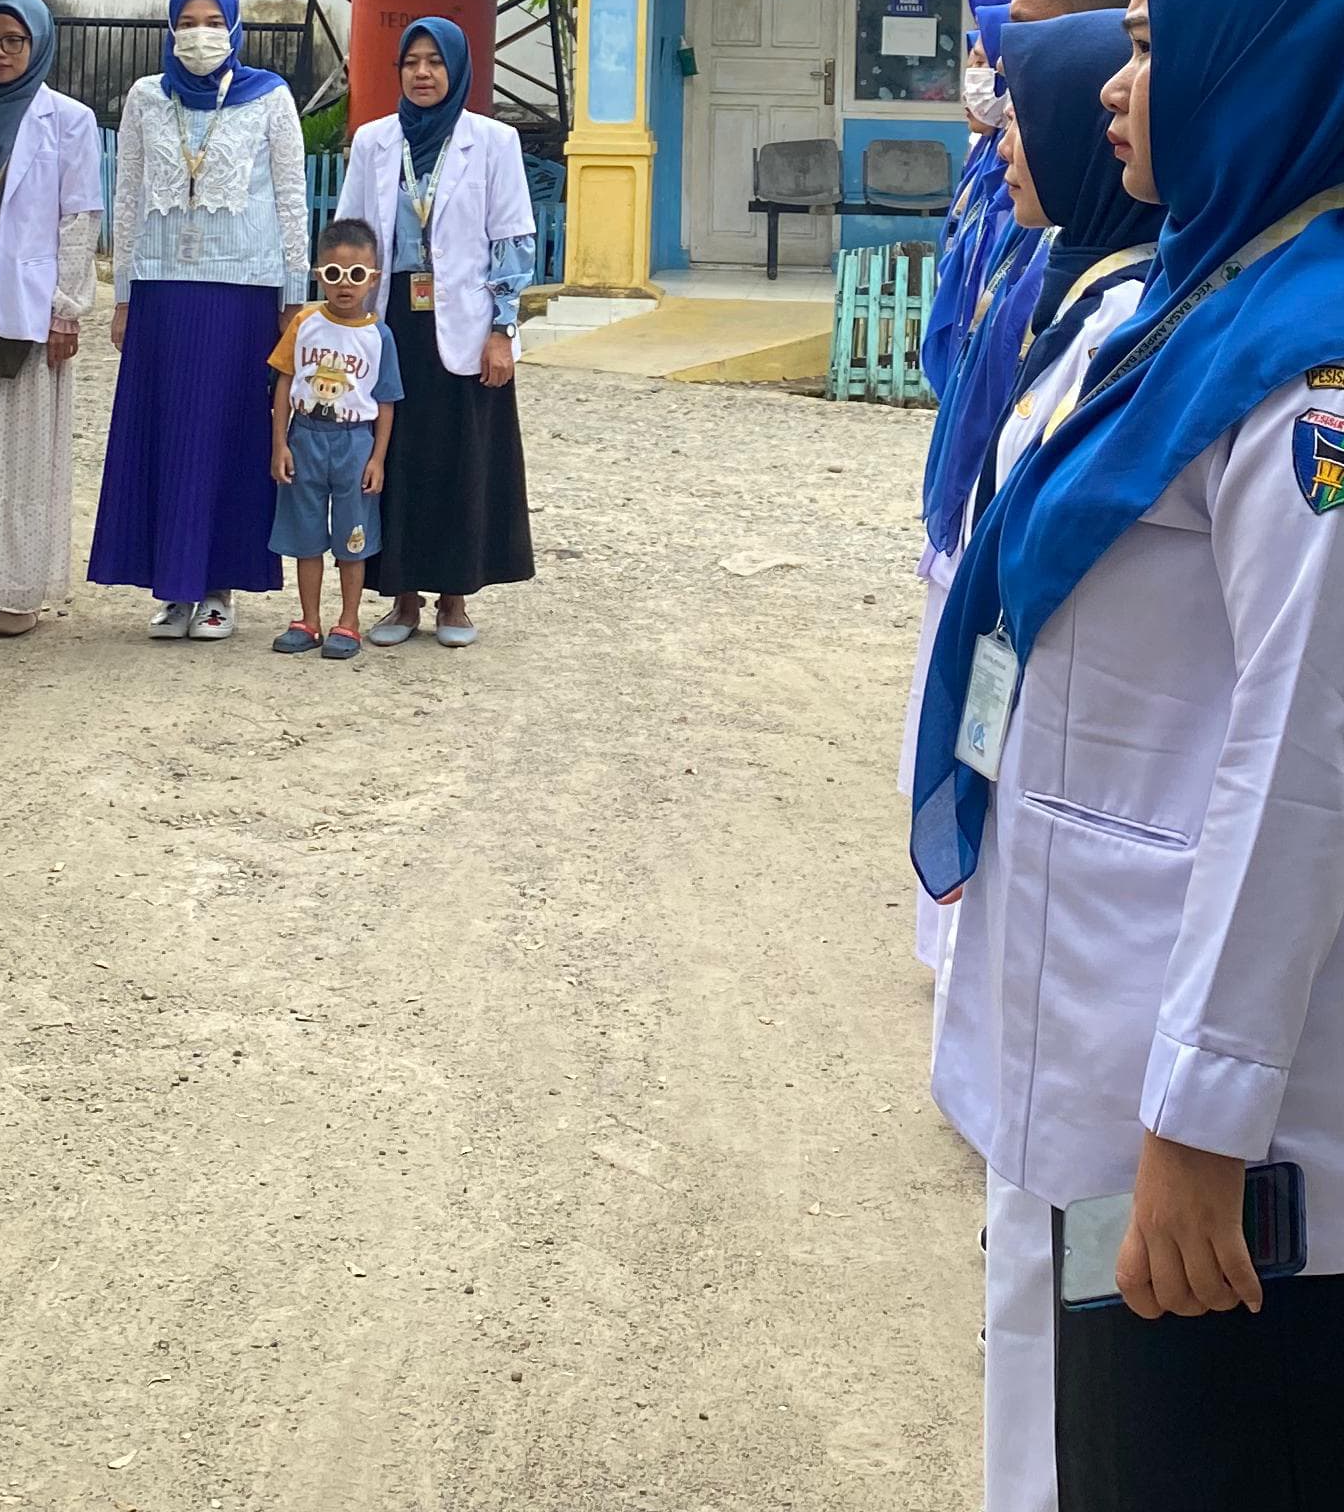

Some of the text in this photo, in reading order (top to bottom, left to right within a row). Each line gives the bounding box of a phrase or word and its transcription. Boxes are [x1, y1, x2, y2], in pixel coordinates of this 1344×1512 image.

[1189, 280, 1213, 303] KEC.
[1164, 300, 1192, 327] BASA
[1134, 324, 1168, 356] AMPEK
[1307, 412, 1344, 429] PESISIR
